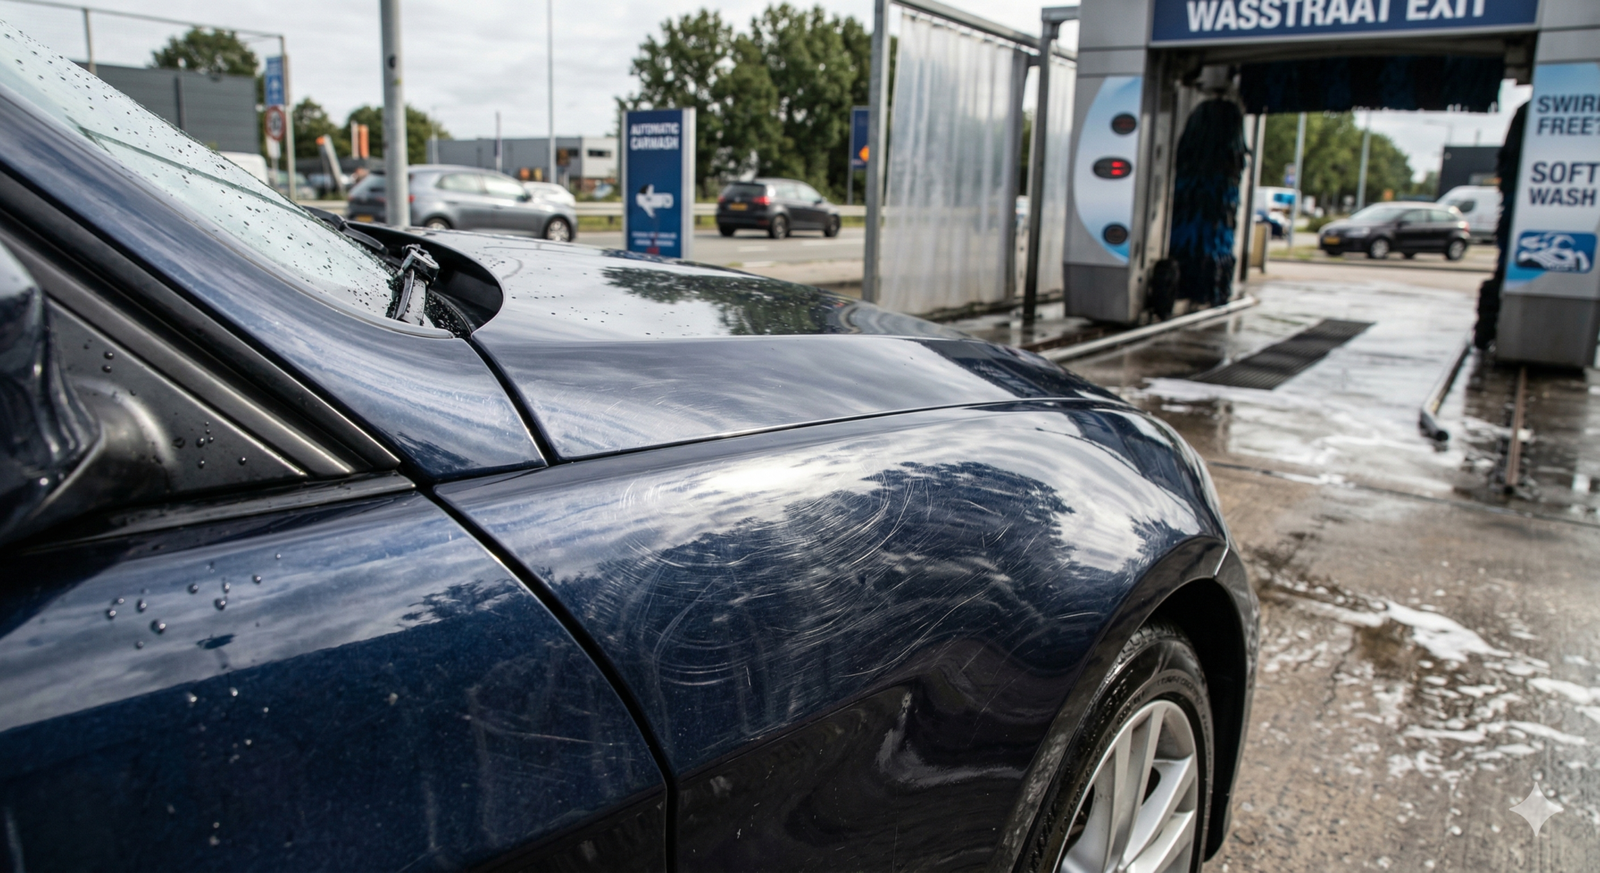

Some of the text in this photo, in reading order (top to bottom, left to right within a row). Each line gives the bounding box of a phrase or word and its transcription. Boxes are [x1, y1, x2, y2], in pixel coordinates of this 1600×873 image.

[1187, 0, 1485, 32] WASSTRAAT EXIT
[1537, 94, 1600, 113] SWIR
[630, 122, 680, 135] AUTOMATIC
[630, 136, 679, 150] CARWASH
[1531, 161, 1600, 184] SOFT
[1529, 187, 1596, 206] WASH
